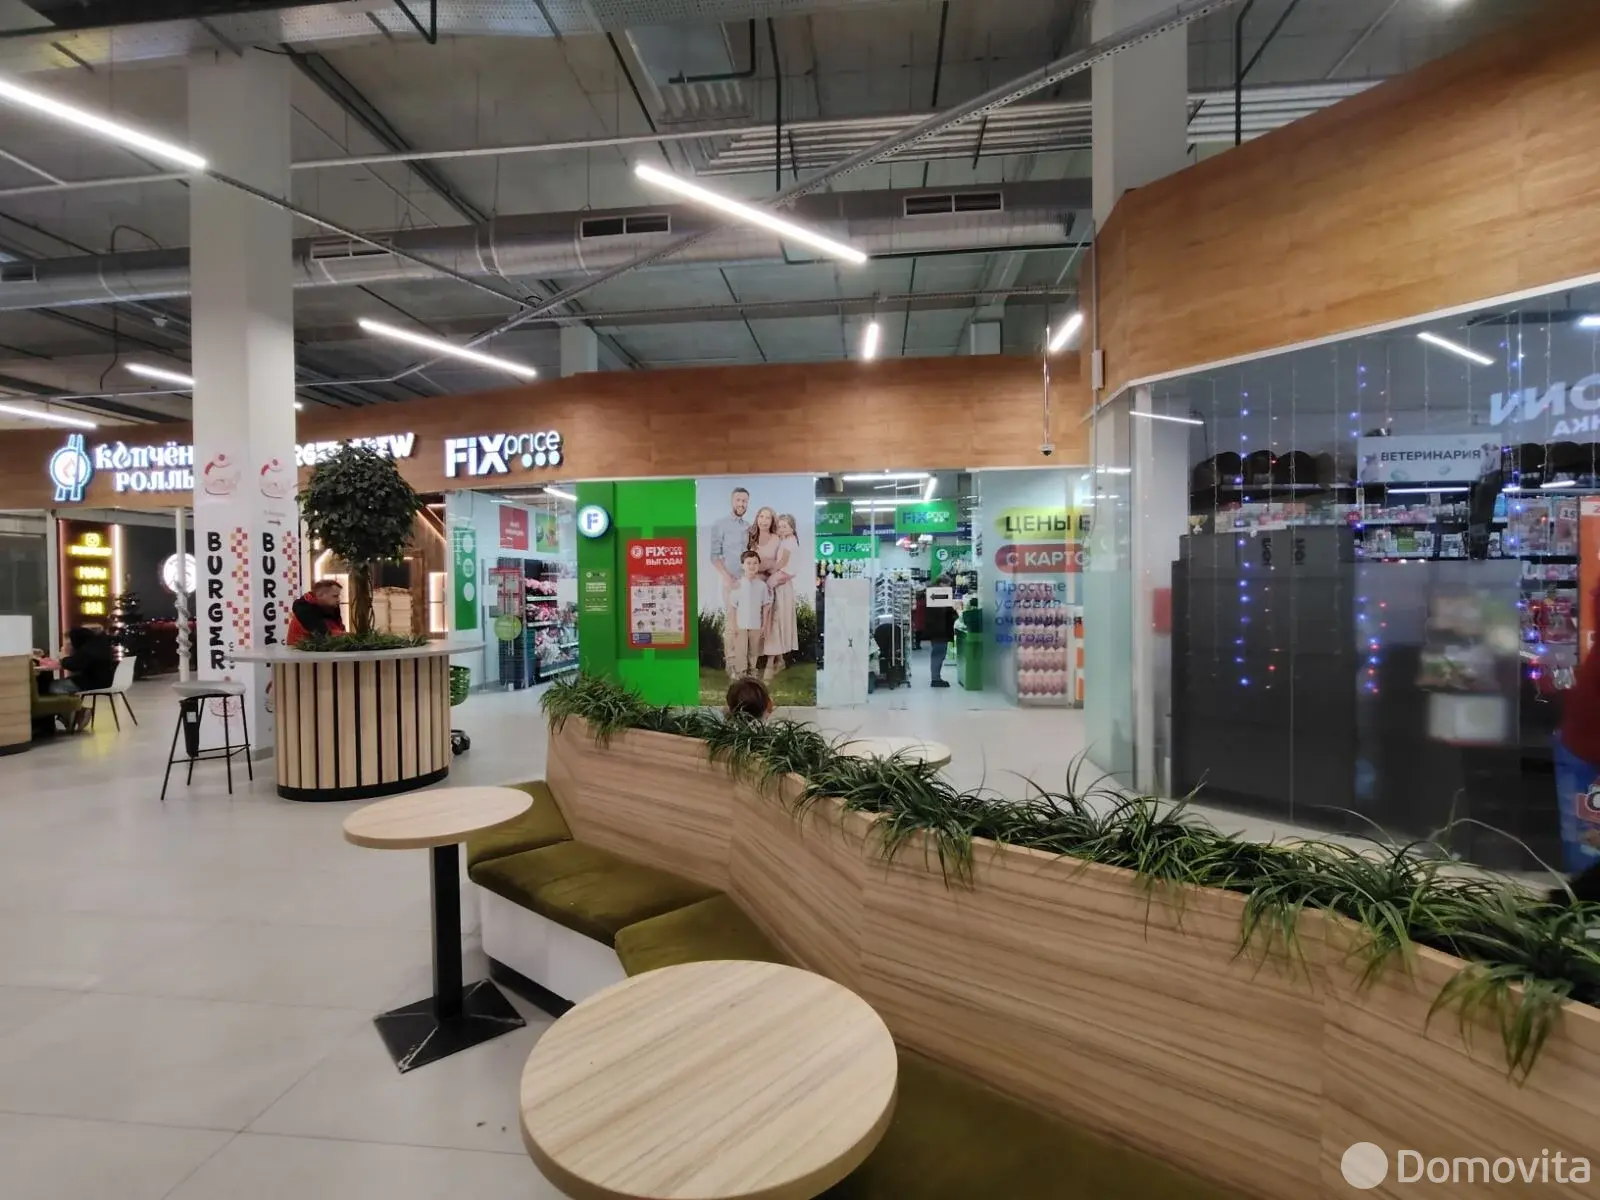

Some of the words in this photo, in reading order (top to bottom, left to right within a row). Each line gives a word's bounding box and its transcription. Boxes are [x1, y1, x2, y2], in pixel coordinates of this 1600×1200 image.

[504, 430, 561, 461] price
[1381, 449, 1481, 461] ВЕТЕРИНАРИЯ
[587, 513, 599, 530] F
[1006, 515, 1070, 533] ЦЕНЫ
[646, 558, 682, 566] ВЫГОДА!
[1006, 553, 1019, 566] С
[995, 580, 1067, 596] Простые
[207, 532, 226, 670] BURGER
[262, 532, 278, 668] BURGE
